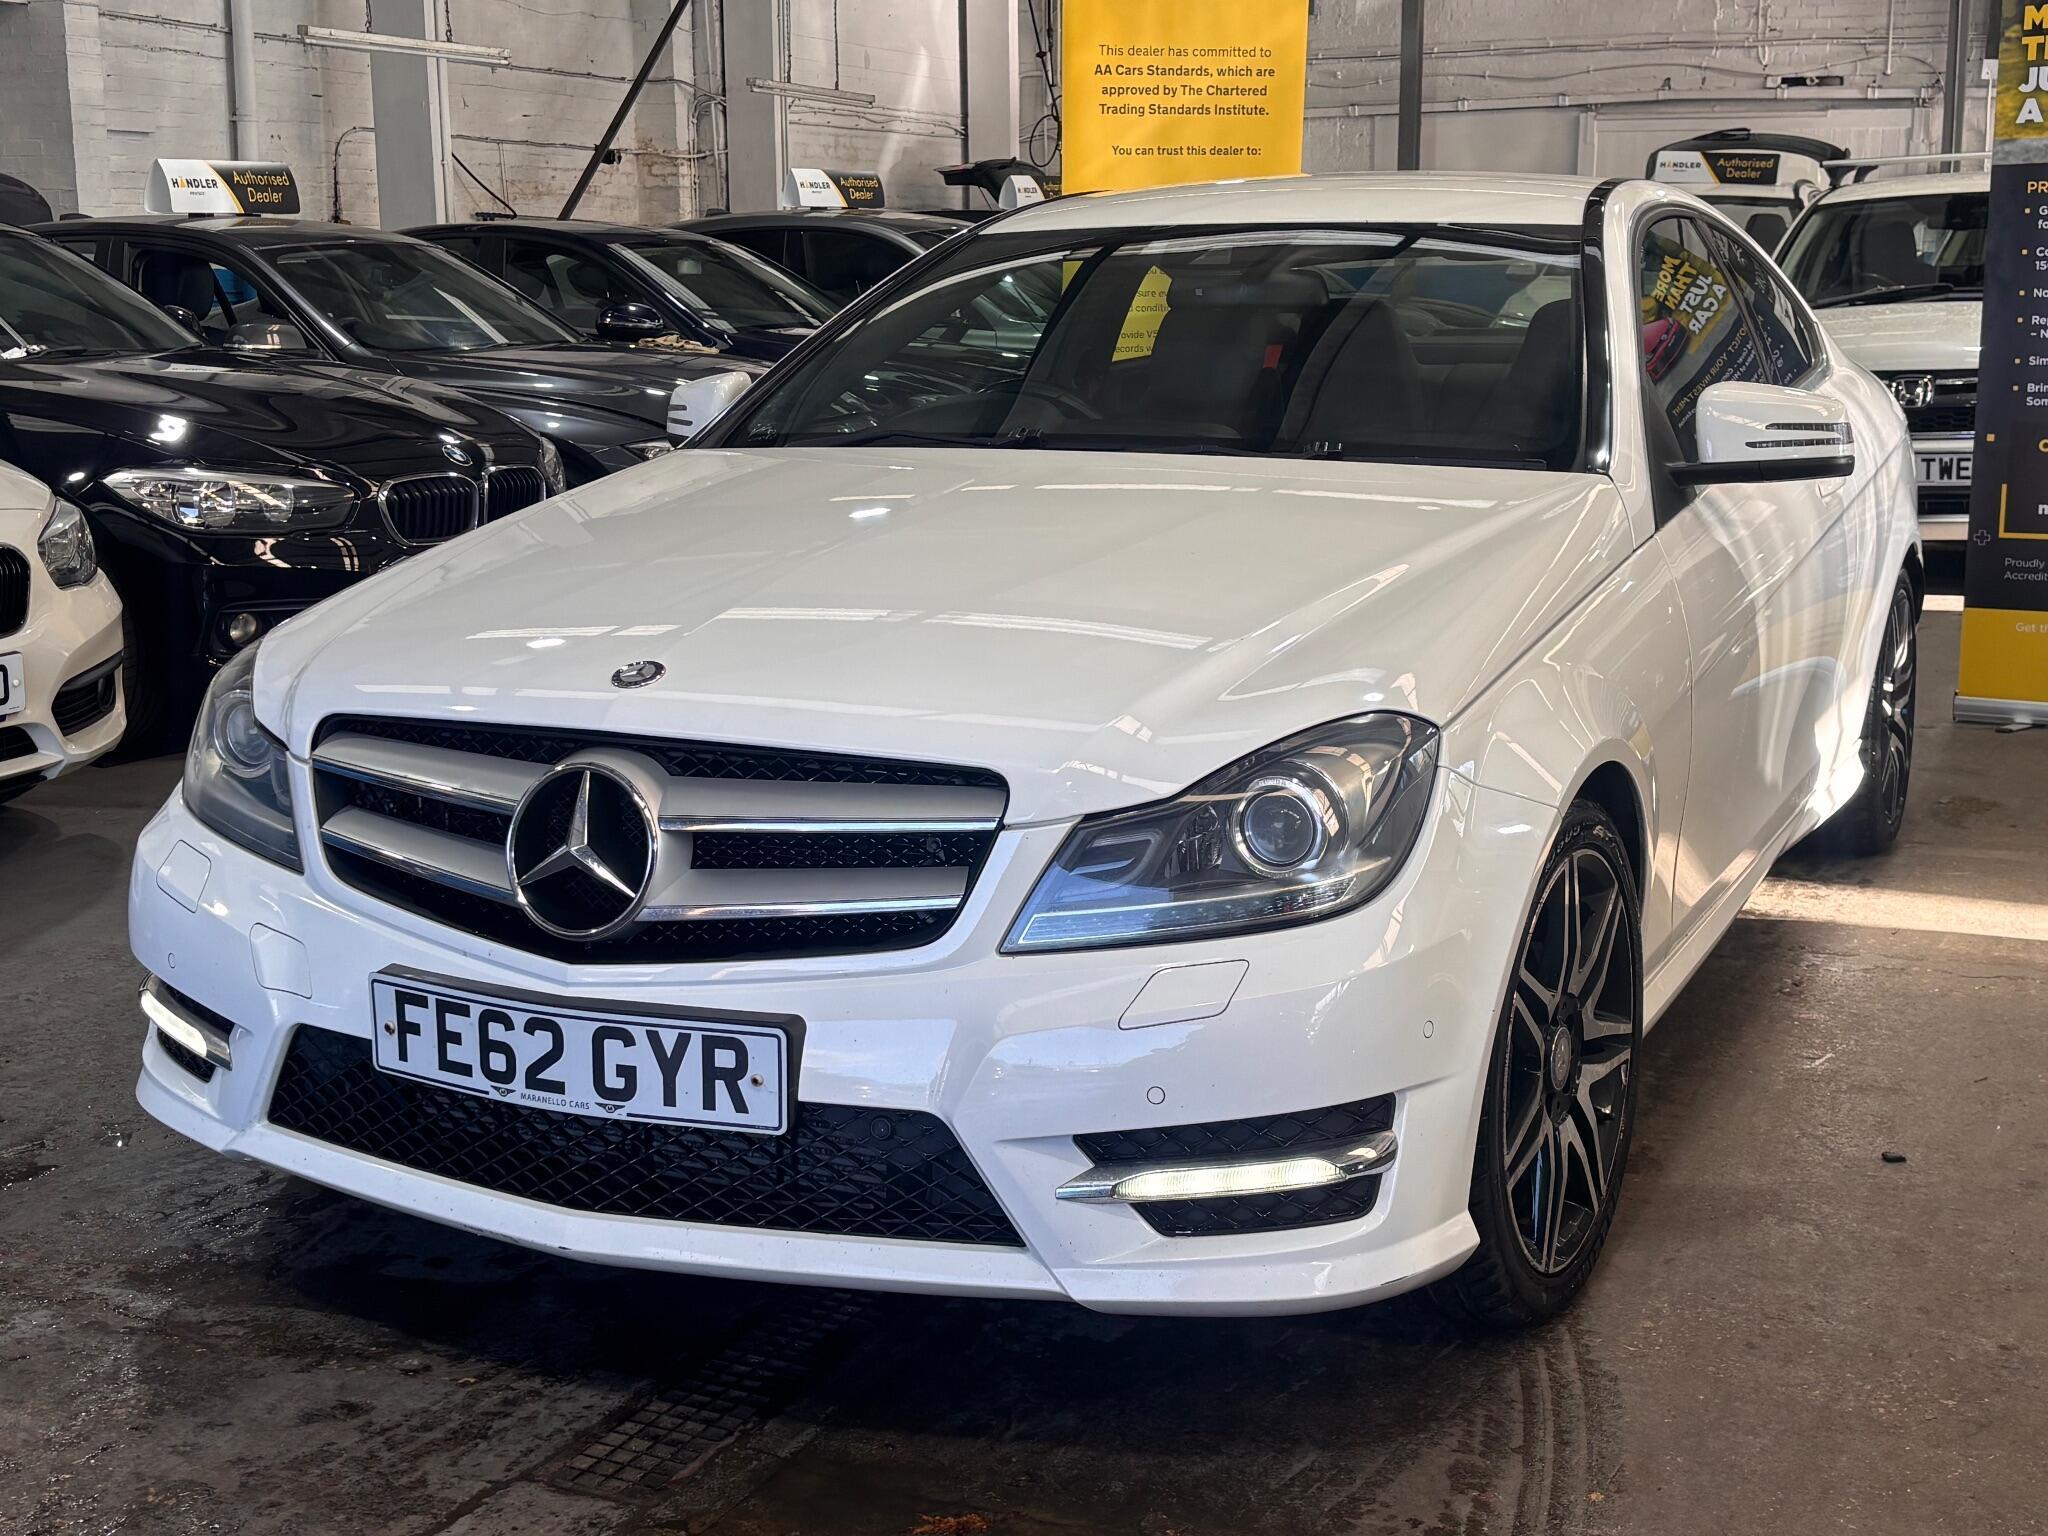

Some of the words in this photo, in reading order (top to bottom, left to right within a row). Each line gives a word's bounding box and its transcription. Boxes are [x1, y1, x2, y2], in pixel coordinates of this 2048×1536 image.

[1099, 44, 1123, 57] This
[1127, 45, 1165, 57] dealer
[1168, 45, 1189, 57] has
[1192, 46, 1256, 58] committed
[1260, 47, 1272, 58] to
[2022, 35, 2048, 60] T
[1094, 64, 1112, 76] AA
[1115, 64, 1143, 76] Cars
[1146, 65, 1213, 78] Standards,
[1217, 66, 1253, 77] which
[1256, 68, 1276, 77] are
[1101, 85, 1159, 97] approved
[1163, 85, 1177, 98] by
[1180, 85, 1203, 96] The
[1206, 85, 1267, 96] Chartered
[1099, 104, 1145, 117] Trading
[1148, 104, 1211, 115] Standards
[1214, 104, 1269, 116] Institute.
[2016, 97, 2044, 124] A
[1112, 145, 1132, 156] You
[1135, 147, 1154, 156] can
[1157, 146, 1183, 156] trust
[1187, 145, 1206, 156] this
[1209, 145, 1244, 156] dealer
[1246, 146, 1262, 156] to:
[1717, 158, 1774, 169] Authorised
[233, 170, 290, 186] Authorised
[1726, 168, 1762, 179] Dealer
[840, 176, 879, 189] Authorised
[248, 187, 283, 203] Dealer
[849, 188, 874, 200] Dealer
[2005, 557, 2045, 569] Proudly
[2015, 622, 2034, 633] Get
[394, 989, 566, 1095] FE62
[591, 1025, 750, 1115] GYR
[520, 1092, 567, 1107] MARANELLO
[569, 1101, 590, 1110] CARS
